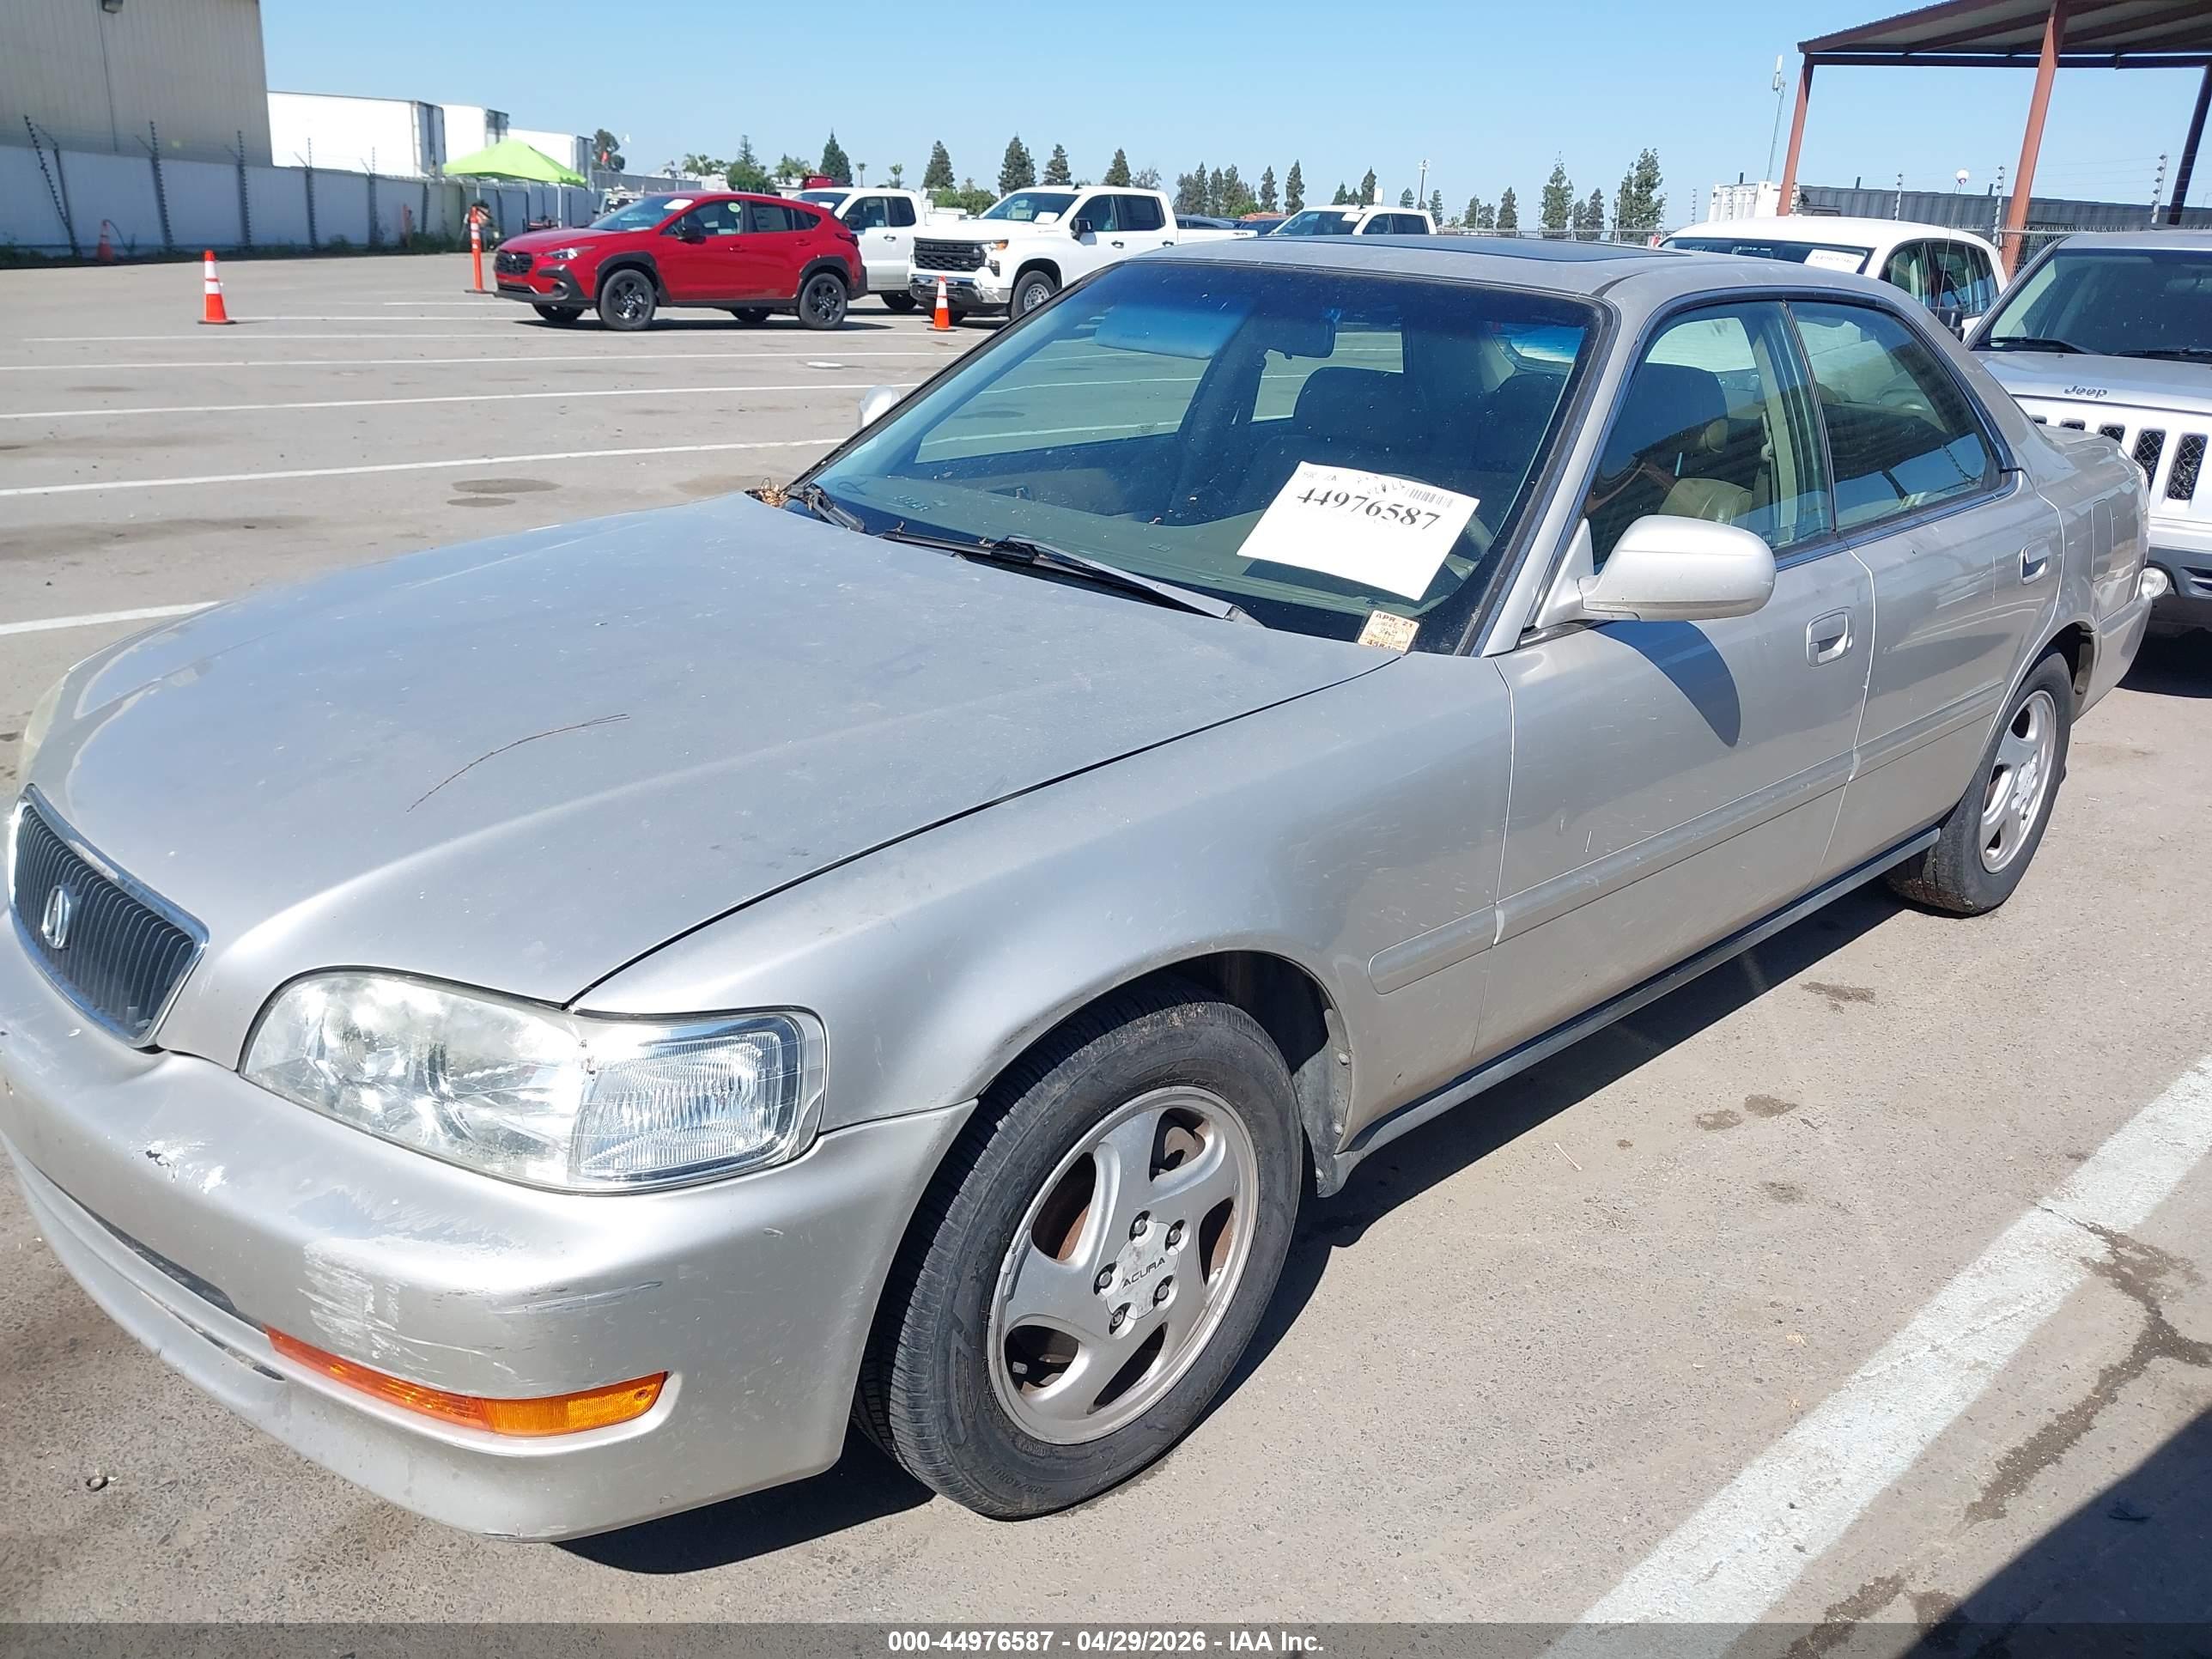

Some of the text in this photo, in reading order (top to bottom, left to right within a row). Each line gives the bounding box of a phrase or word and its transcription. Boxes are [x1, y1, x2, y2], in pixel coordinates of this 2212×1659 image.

[2063, 385, 2108, 398] Jeep
[1297, 488, 1440, 529] 44976587
[1376, 612, 1396, 623] APR
[1121, 1257, 1165, 1289] ACURA
